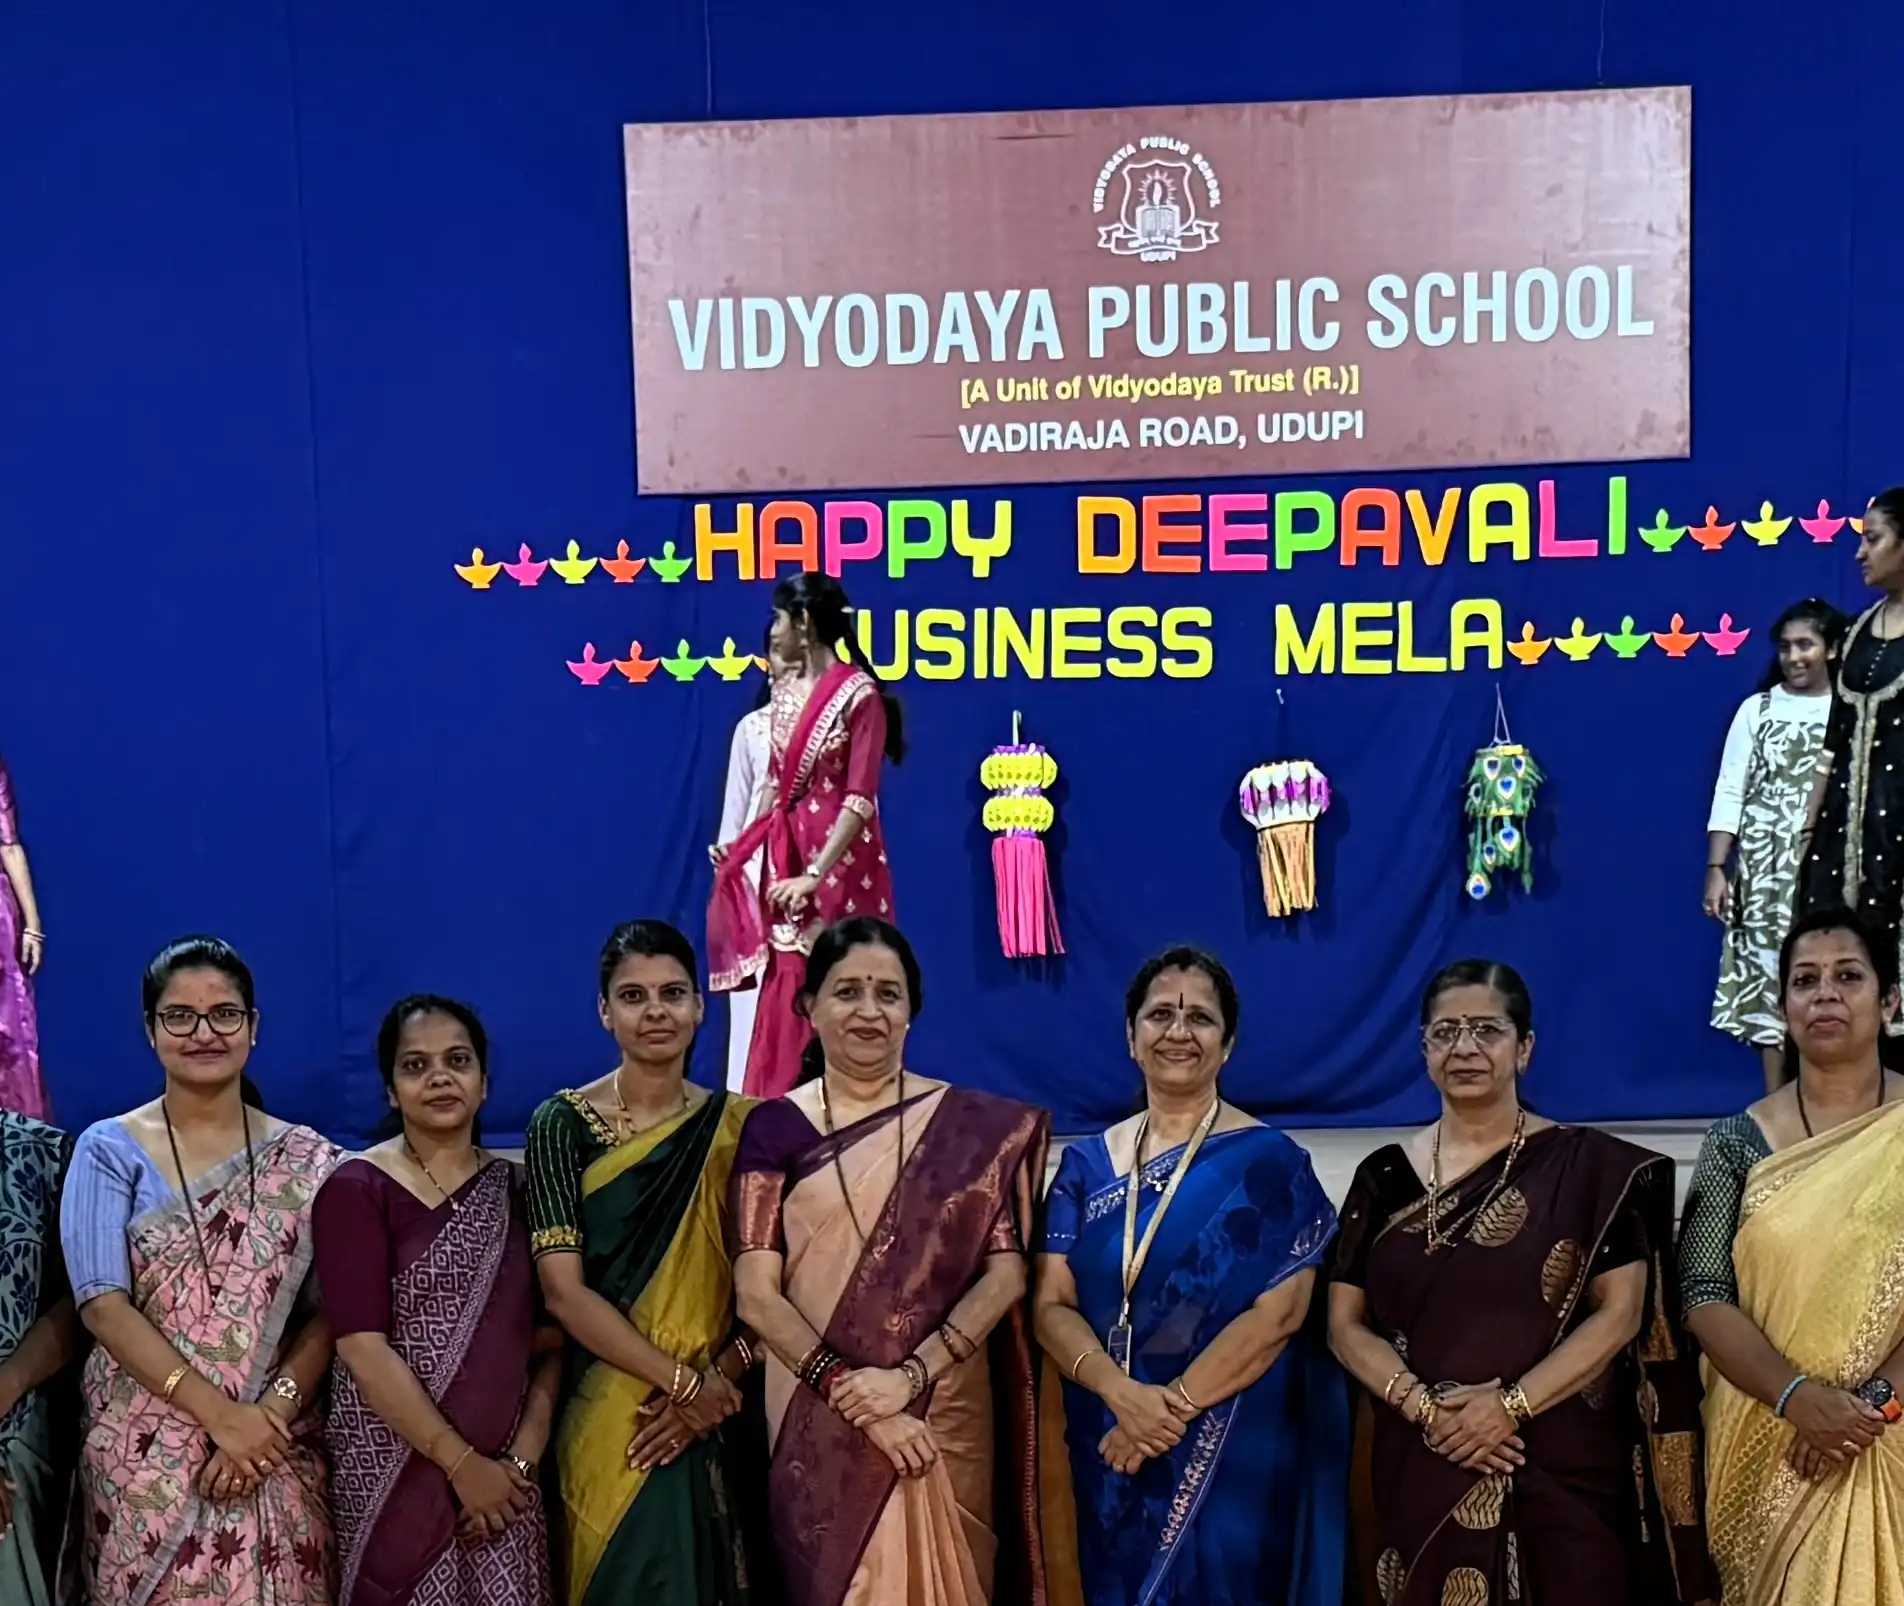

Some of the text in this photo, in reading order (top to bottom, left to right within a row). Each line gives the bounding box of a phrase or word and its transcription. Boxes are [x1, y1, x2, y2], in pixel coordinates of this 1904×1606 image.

[1140, 136, 1190, 155] PUBLIC
[1192, 152, 1221, 208] SCHOOL
[667, 264, 1655, 371] VIDYODAYA PUBLIC SCHOOL
[961, 365, 1360, 409] [A Unit of Vidyodaya Trust (R.)]
[958, 410, 1364, 454] VADIRAJA ROAD, UDUPI
[694, 476, 1628, 581] HAPPY DEEPAVALI
[834, 598, 1503, 681] USINESS MELA
